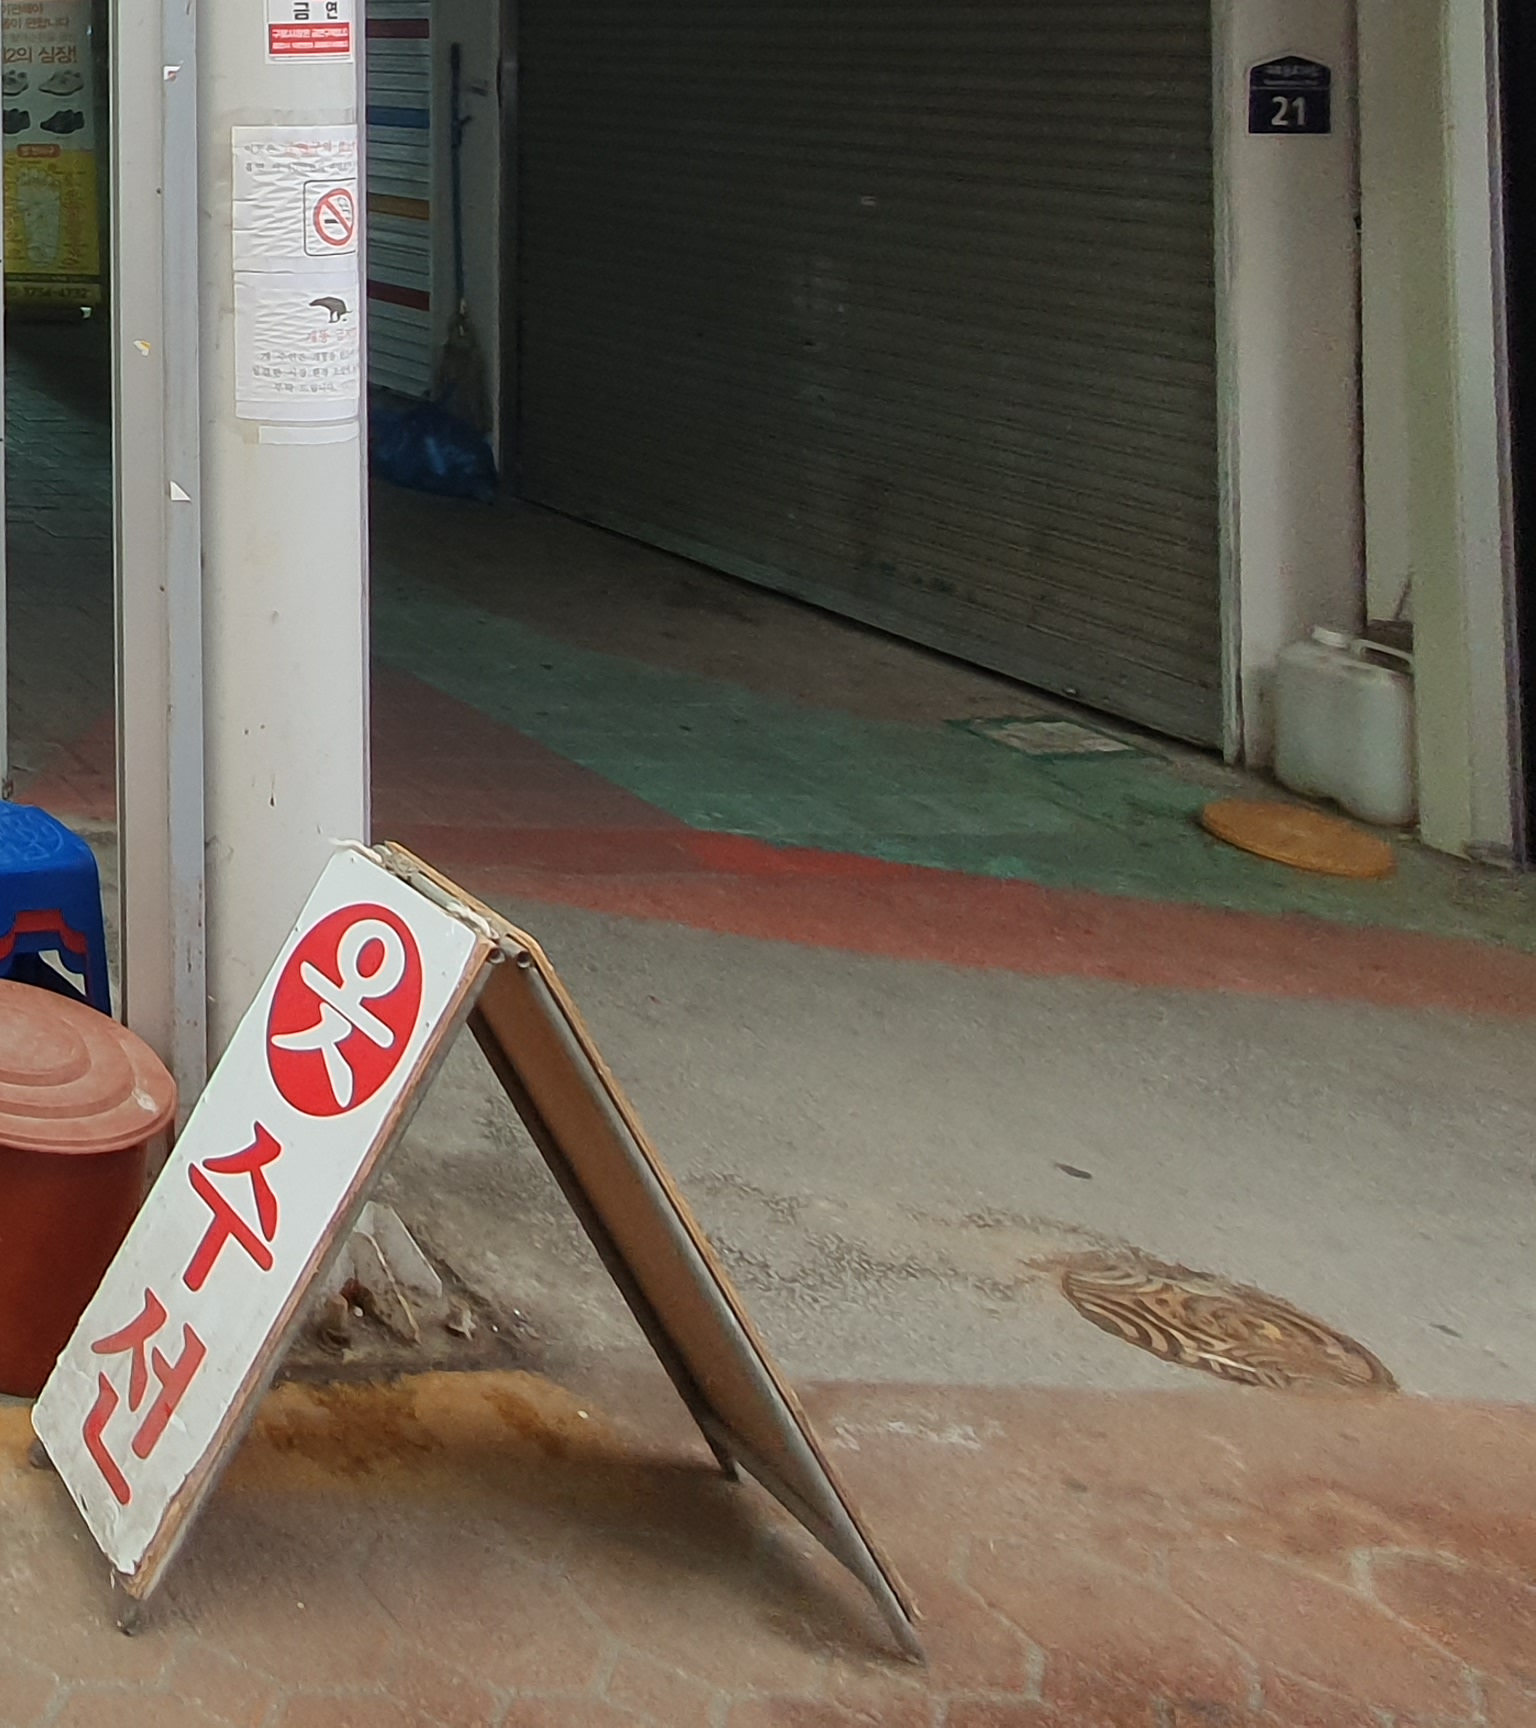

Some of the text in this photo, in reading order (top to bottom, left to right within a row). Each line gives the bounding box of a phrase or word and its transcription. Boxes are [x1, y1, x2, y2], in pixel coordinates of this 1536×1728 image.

[3, 46, 33, 65] 2의
[1270, 95, 1307, 126] 21
[270, 917, 407, 1109] 옷
